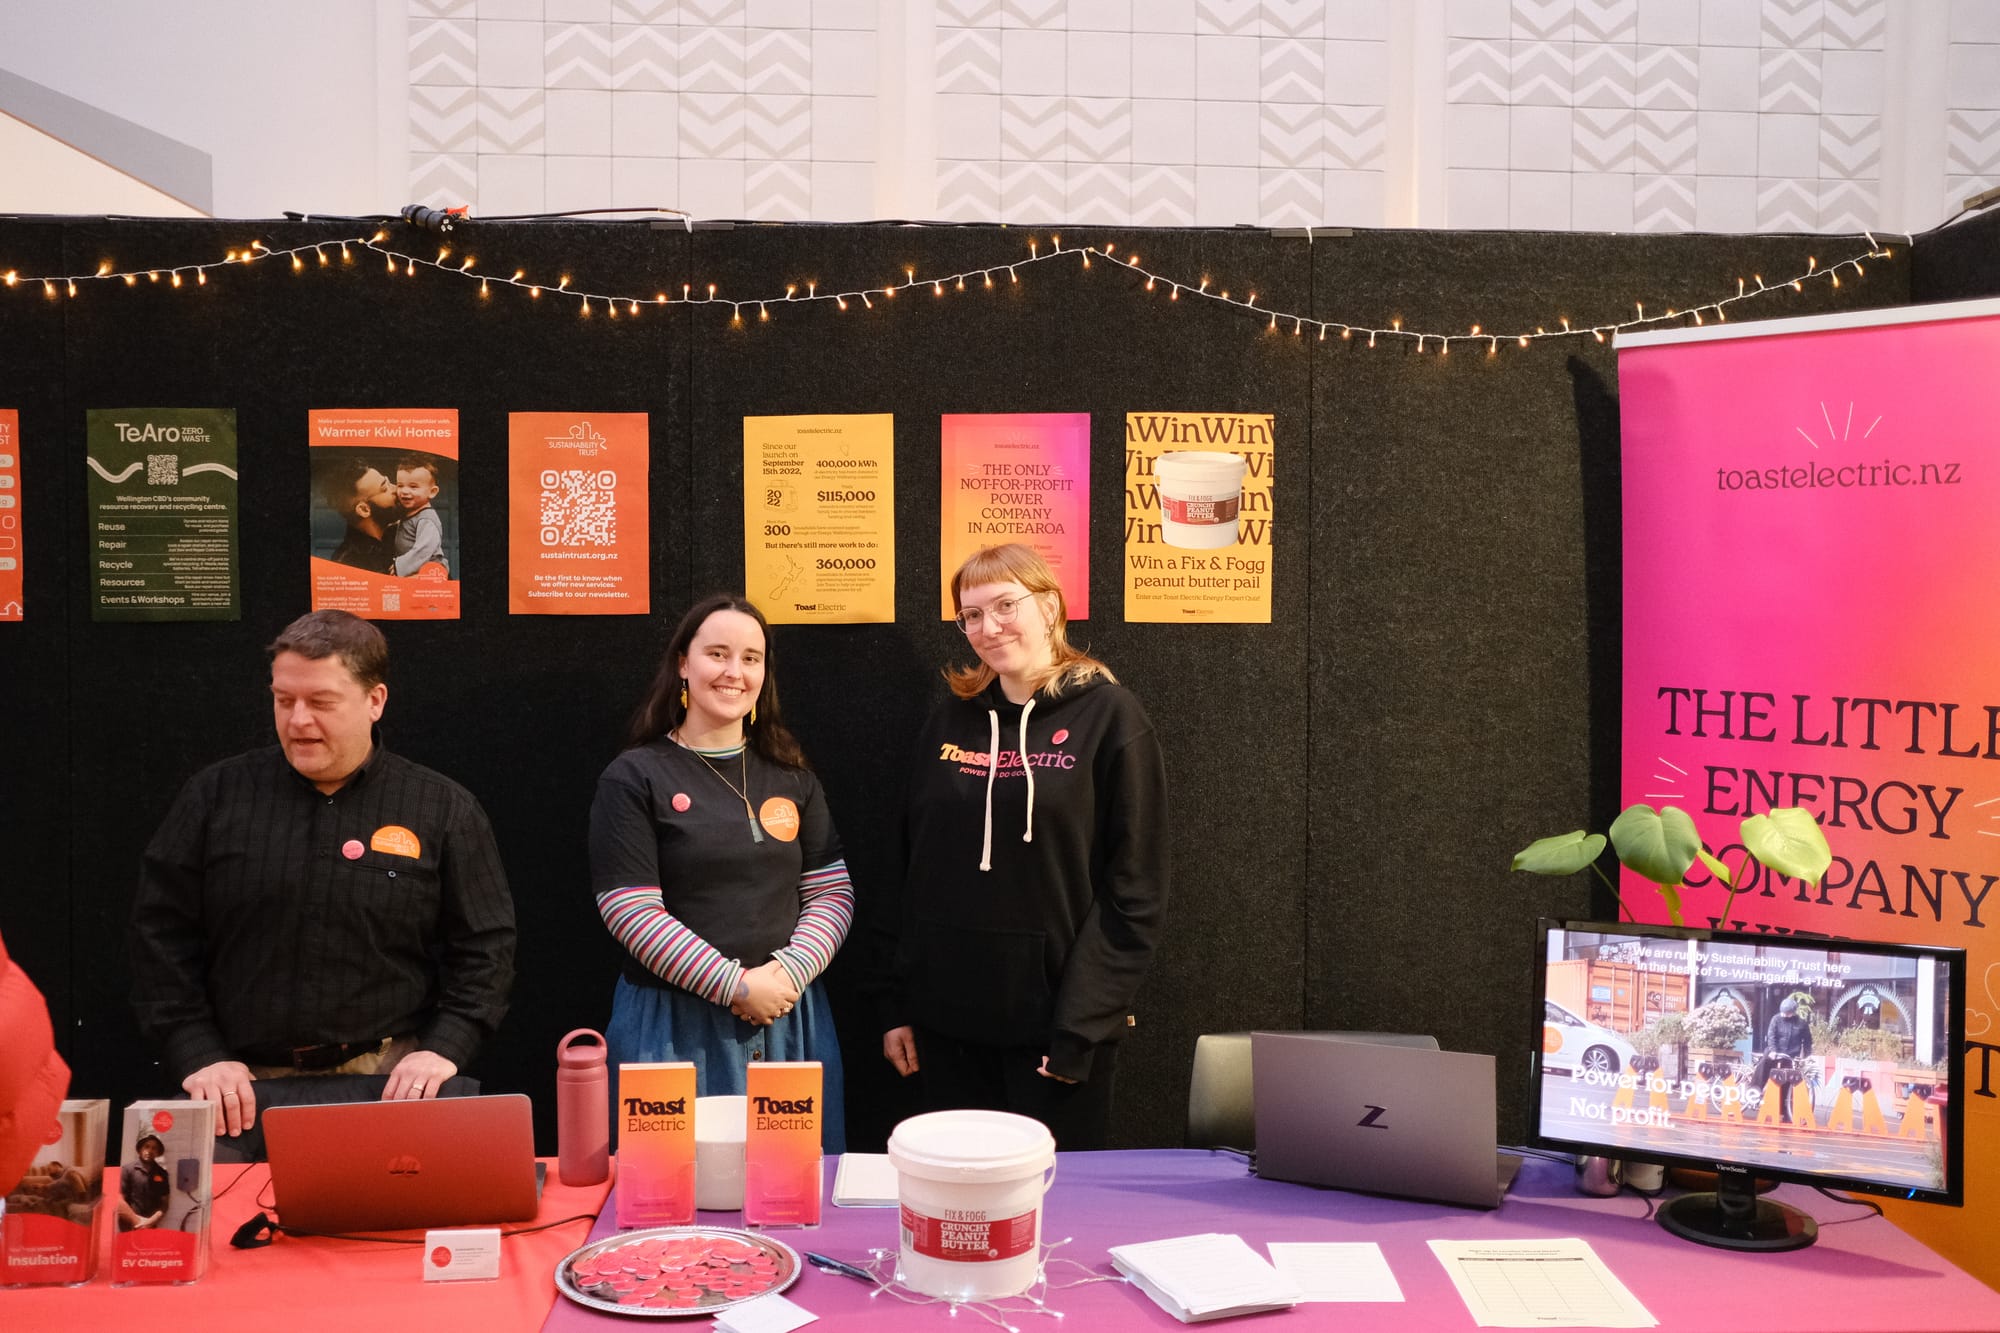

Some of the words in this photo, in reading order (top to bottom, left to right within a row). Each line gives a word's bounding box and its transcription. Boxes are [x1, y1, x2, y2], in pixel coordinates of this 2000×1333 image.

[181, 427, 203, 435] ZERO
[318, 426, 371, 438] Warmer
[374, 426, 402, 438] Kiwi
[405, 426, 451, 438] Homes
[182, 435, 210, 443] WASTE
[762, 460, 805, 468] September
[816, 460, 857, 468] 400,000
[858, 460, 878, 468] kWh
[983, 464, 1012, 476] THE
[1014, 464, 1051, 476] ONLY
[1716, 459, 1962, 491] toastelectric.nz
[960, 478, 1074, 491] NOT-FOR-PROFIT
[116, 495, 152, 503] Wellington
[173, 495, 210, 503] community
[766, 490, 782, 499] 20
[817, 490, 876, 503] $115,000
[990, 493, 1043, 505] POWER
[173, 503, 202, 511] recycling
[766, 498, 781, 507] 22
[981, 508, 1052, 520] COMPANY
[98, 523, 126, 531] Reuse
[764, 525, 791, 536] 300
[967, 522, 982, 534] IN
[986, 522, 1065, 534] AOTEAROA
[99, 541, 126, 550] Repair
[540, 552, 618, 560] sustaintrust.org.nz
[99, 560, 133, 570] Recycle
[815, 559, 876, 571] 360,000
[1130, 555, 1164, 570] Win
[1167, 559, 1177, 570] a
[1181, 556, 1206, 570] Fix
[1209, 557, 1222, 571] &
[1226, 557, 1266, 574] Fogg
[1134, 577, 1185, 589] peanut
[1188, 575, 1230, 588] butter
[1233, 576, 1260, 591] pail
[138, 595, 185, 605] Workshops
[794, 603, 816, 611] Toast
[818, 603, 846, 611] Electric
[1657, 686, 1777, 743] THE
[997, 750, 1076, 769] Electric
[959, 767, 987, 777] POWER
[1633, 946, 1652, 958] We
[1654, 950, 1673, 959] are
[1697, 952, 1709, 965] by
[1712, 953, 1789, 970] Sustainability
[1790, 959, 1822, 971] Trust
[1823, 962, 1851, 974] here
[1648, 962, 1667, 972] the
[1701, 967, 1713, 976] of
[1571, 1064, 1642, 1090] Power
[1645, 1072, 1677, 1095] for
[1679, 1082, 1766, 1106] people.
[624, 1097, 686, 1116] Toast
[752, 1096, 814, 1115] Toast
[1569, 1097, 1607, 1120] Not
[1610, 1104, 1677, 1129] profit.
[627, 1118, 686, 1132] Electric
[756, 1116, 814, 1130] Electric
[1716, 1163, 1747, 1174] ViewSonic
[944, 1209, 957, 1221] FIX
[957, 1211, 964, 1221] &
[965, 1209, 987, 1222] FOGG
[940, 1221, 991, 1232] CRUNCHY
[941, 1231, 990, 1241] PEANUT
[941, 1240, 990, 1250] BUTTER
[8, 1253, 78, 1267] Insulation
[122, 1259, 136, 1269] EV
[138, 1259, 183, 1269] Chargers
